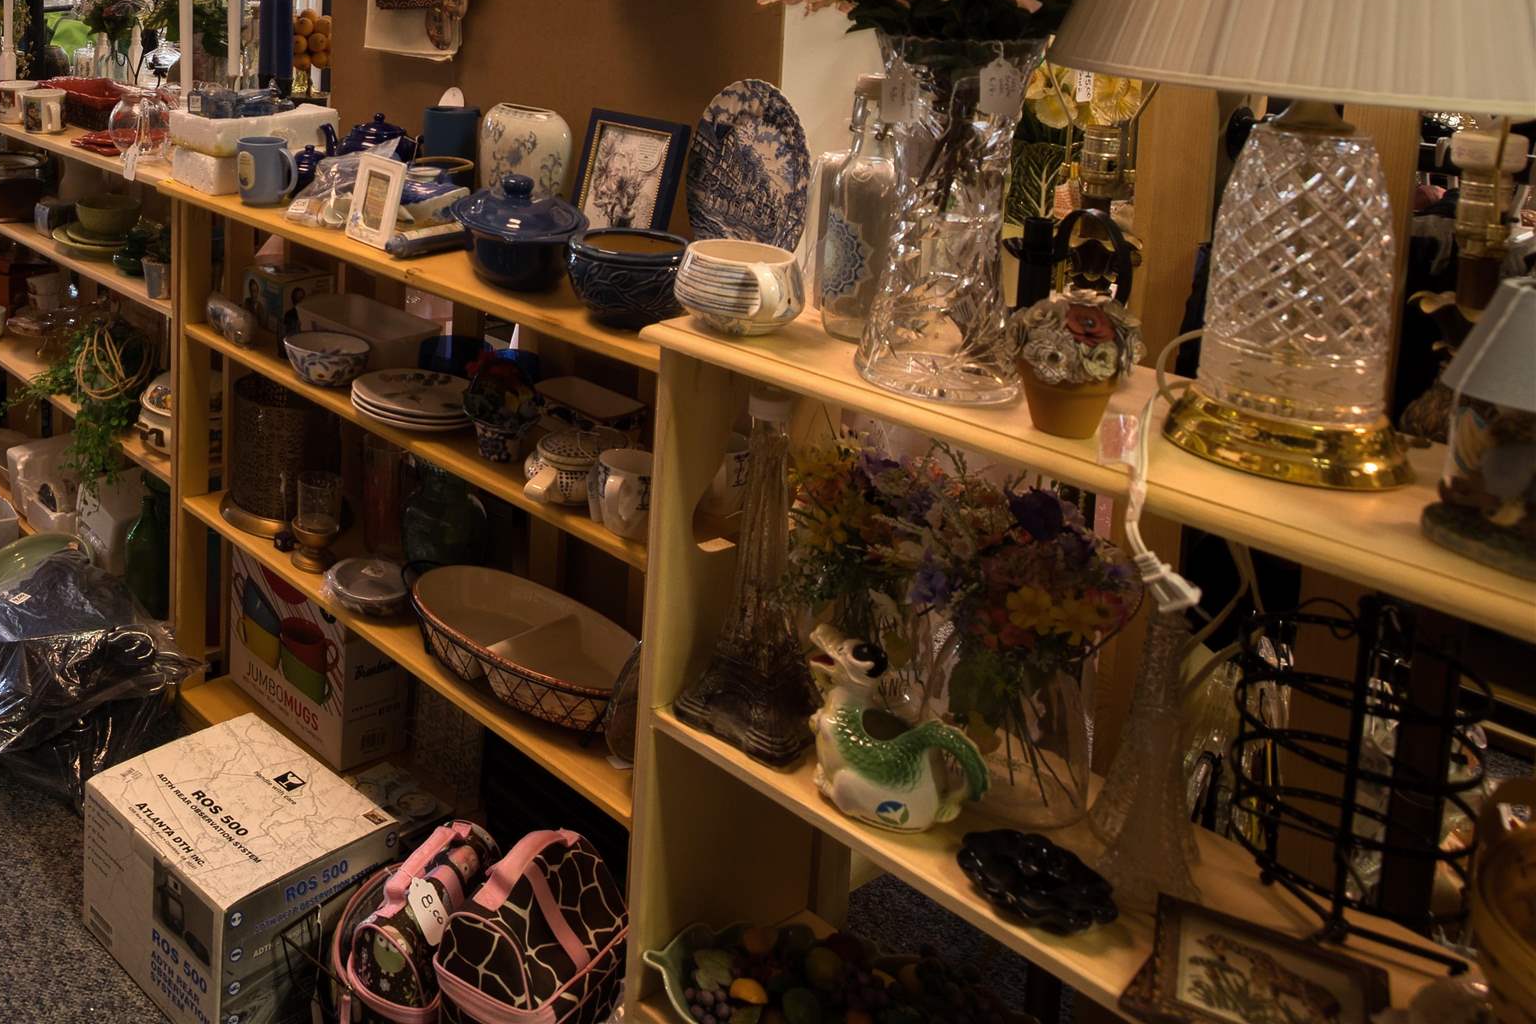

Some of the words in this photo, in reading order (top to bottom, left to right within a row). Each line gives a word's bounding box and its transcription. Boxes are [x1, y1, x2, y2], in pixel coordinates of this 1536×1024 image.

[135, 802, 175, 837] ATLANTA
[172, 834, 195, 854] DTH
[157, 773, 174, 790] ADTH
[173, 787, 192, 805] REAR
[191, 804, 234, 843] OBSERVATION
[233, 840, 263, 864] SYSTEM
[191, 789, 223, 815] ROS
[220, 814, 249, 836] 500
[284, 878, 318, 905] ROS
[322, 859, 349, 884] 500
[151, 927, 179, 964] ROS
[183, 960, 207, 993] 500
